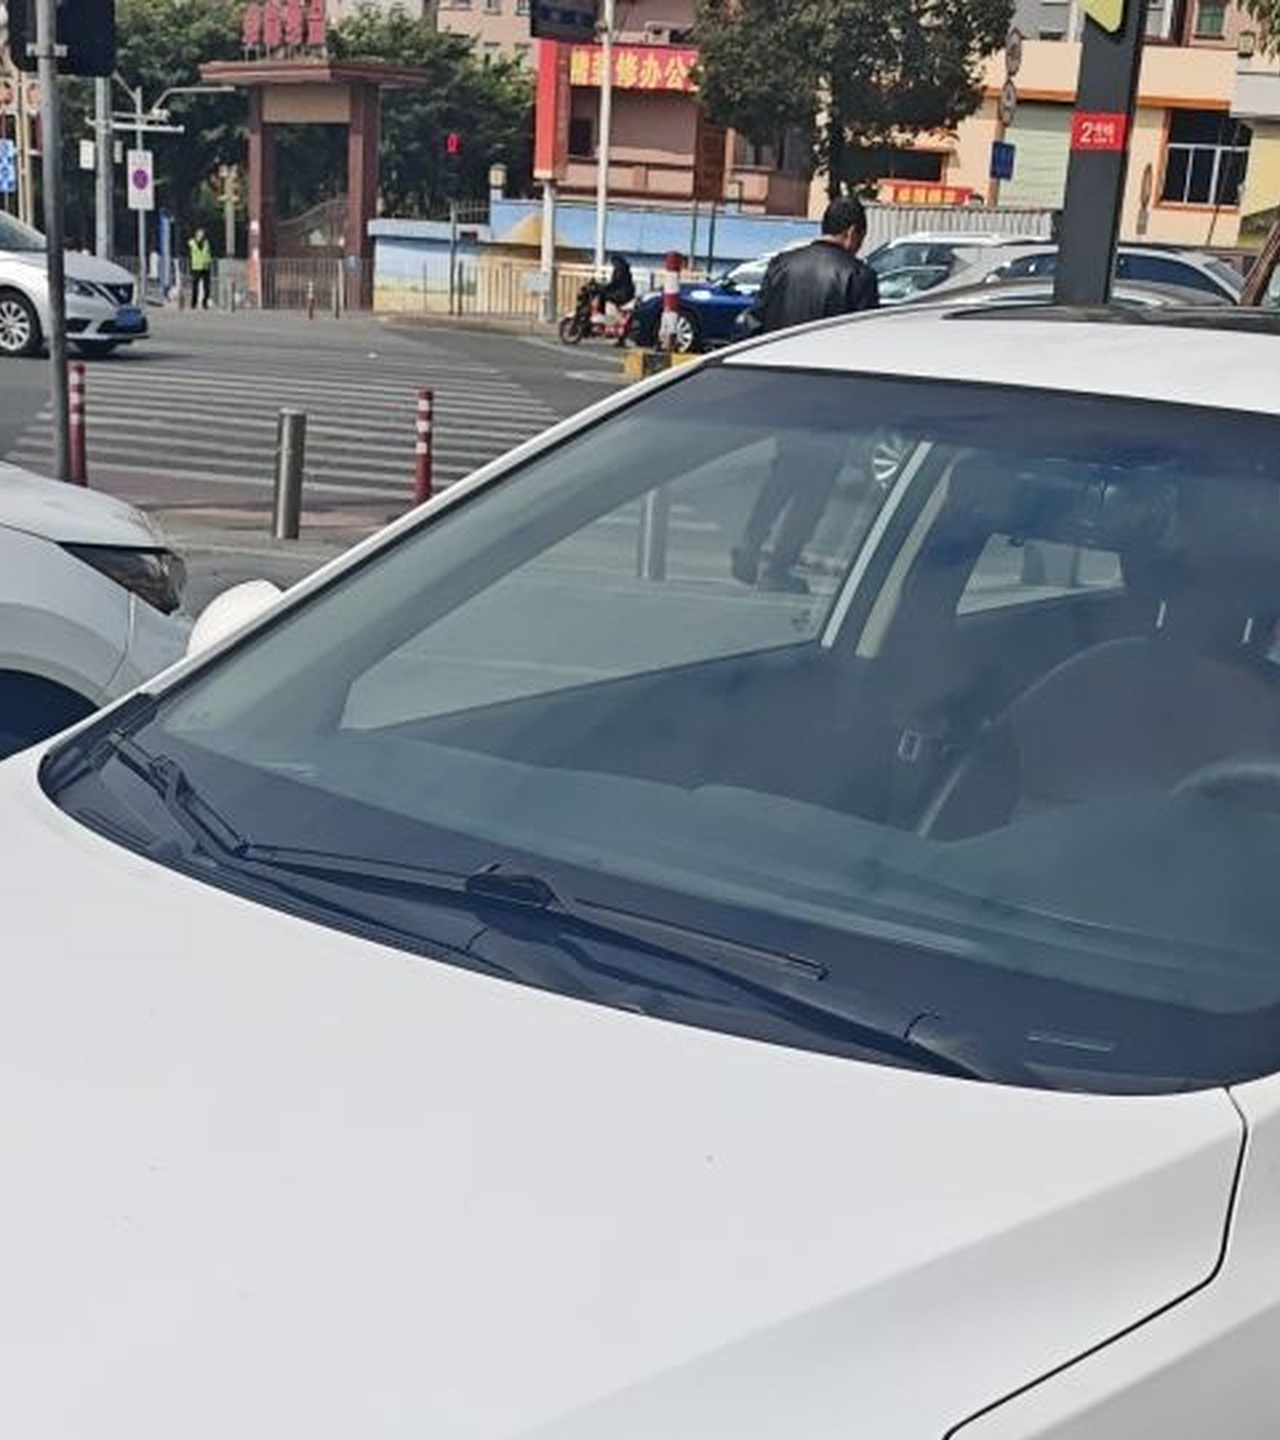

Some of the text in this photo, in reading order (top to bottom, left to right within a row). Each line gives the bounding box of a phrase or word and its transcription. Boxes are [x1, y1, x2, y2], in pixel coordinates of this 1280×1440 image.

[571, 48, 700, 91] 精装修办公
